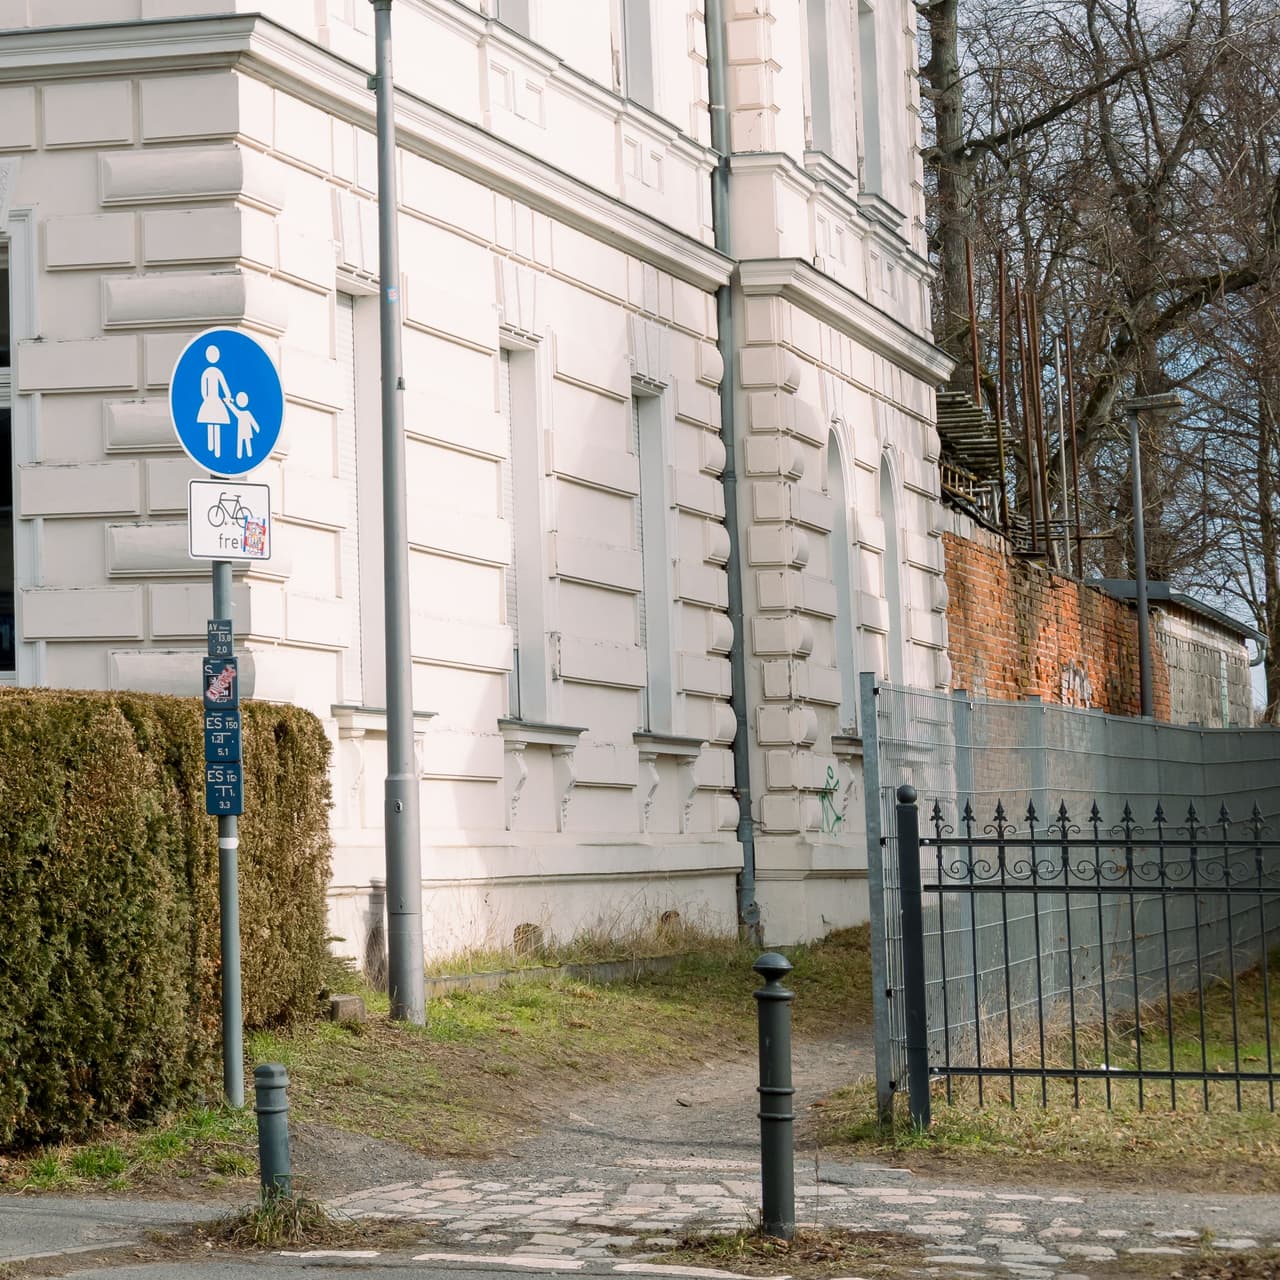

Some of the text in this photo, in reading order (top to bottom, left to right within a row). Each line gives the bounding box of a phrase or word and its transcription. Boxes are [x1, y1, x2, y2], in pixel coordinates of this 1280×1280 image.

[219, 532, 243, 550] frei
[206, 717, 239, 729] ES 150
[207, 770, 224, 782] ES
